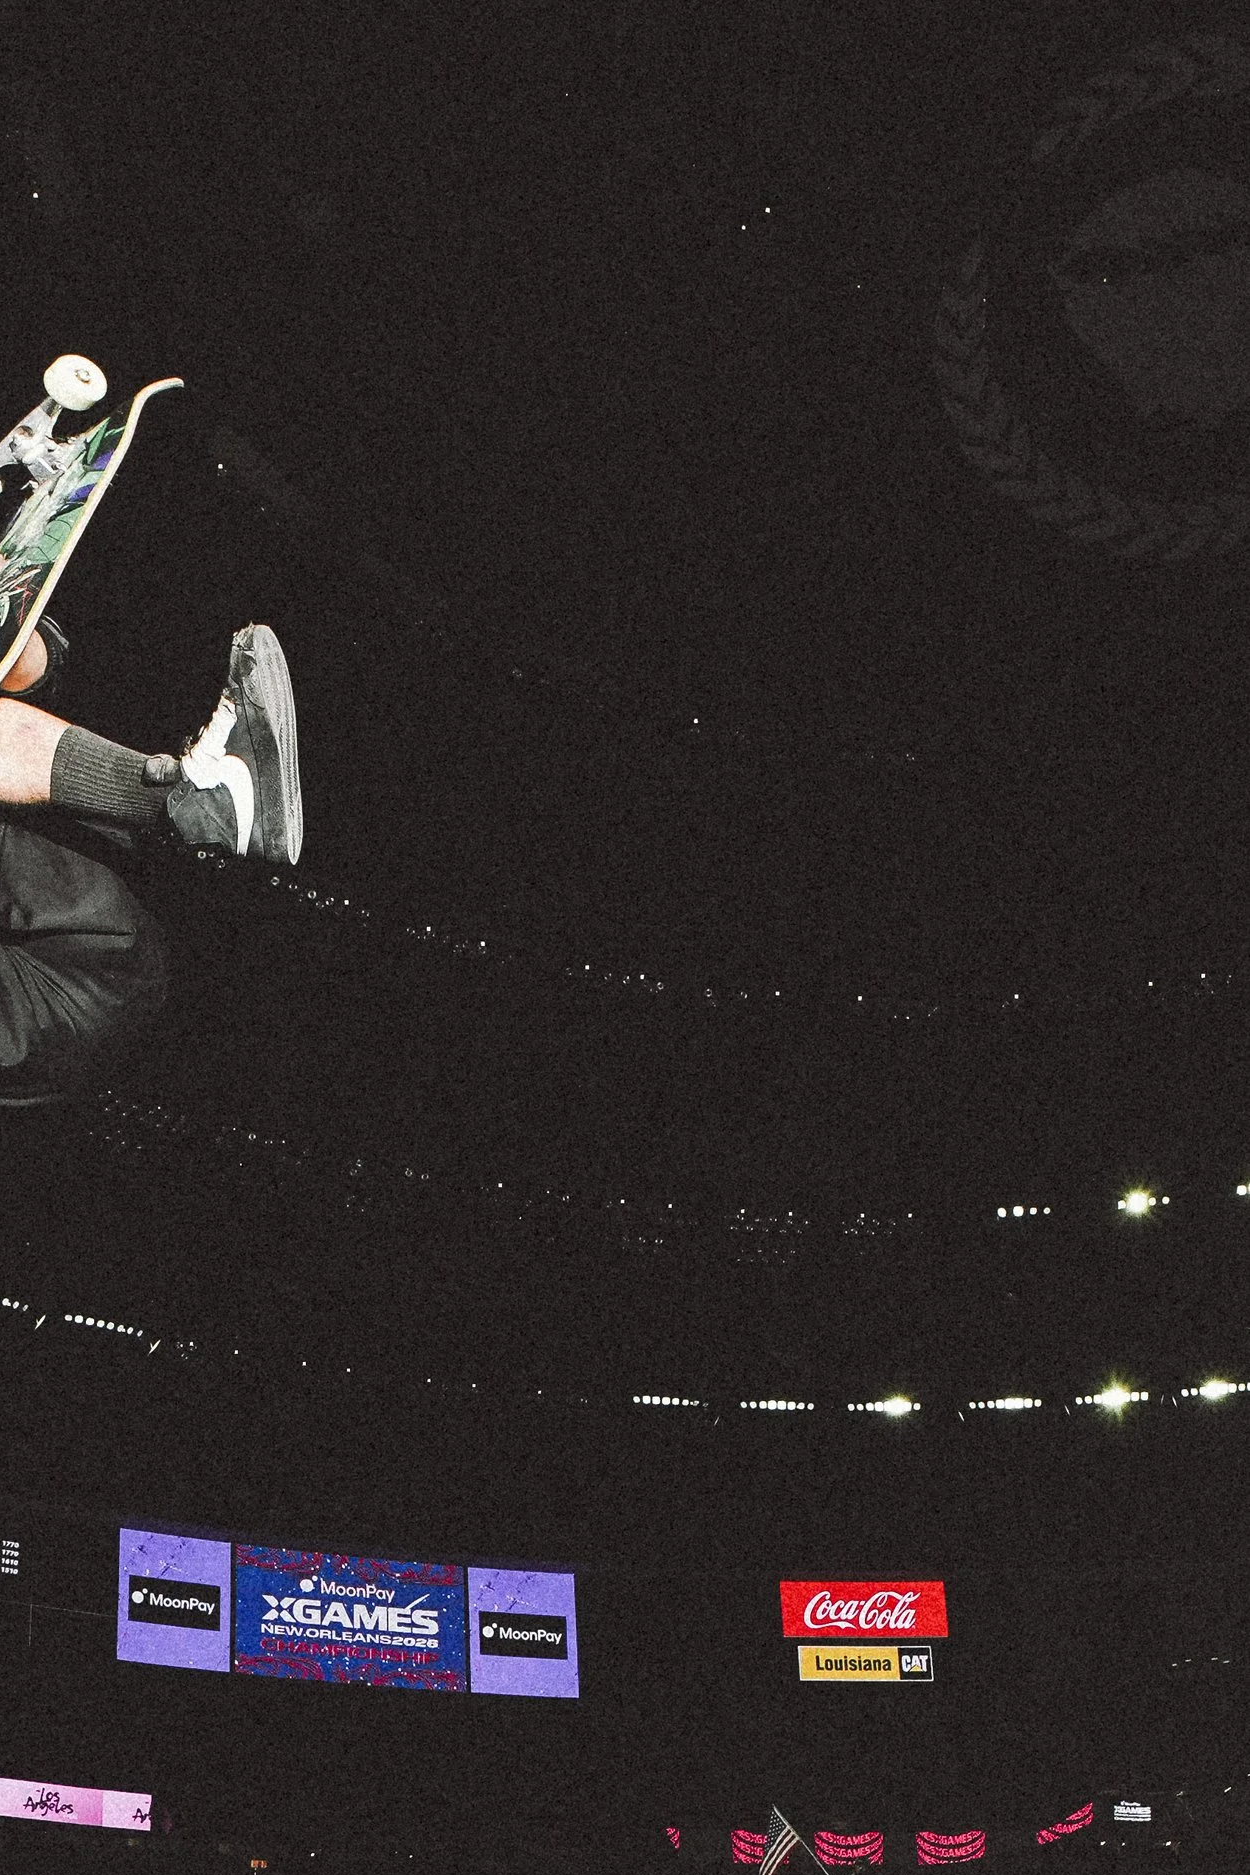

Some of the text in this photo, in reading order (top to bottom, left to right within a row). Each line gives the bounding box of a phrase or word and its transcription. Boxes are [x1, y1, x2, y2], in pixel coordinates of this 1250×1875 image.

[2, 1540, 20, 1549] 1770
[2, 1549, 20, 1557] 1770
[1, 1558, 19, 1566] 1610
[320, 1578, 395, 1603] MoonPay
[150, 1592, 215, 1615] MoonPay
[803, 1590, 922, 1630] Coca-Cola
[499, 1626, 563, 1646] MoonPay
[260, 1637, 439, 1665] CHAMPIONSHIP
[815, 1655, 928, 1672] Louisiana CAT
